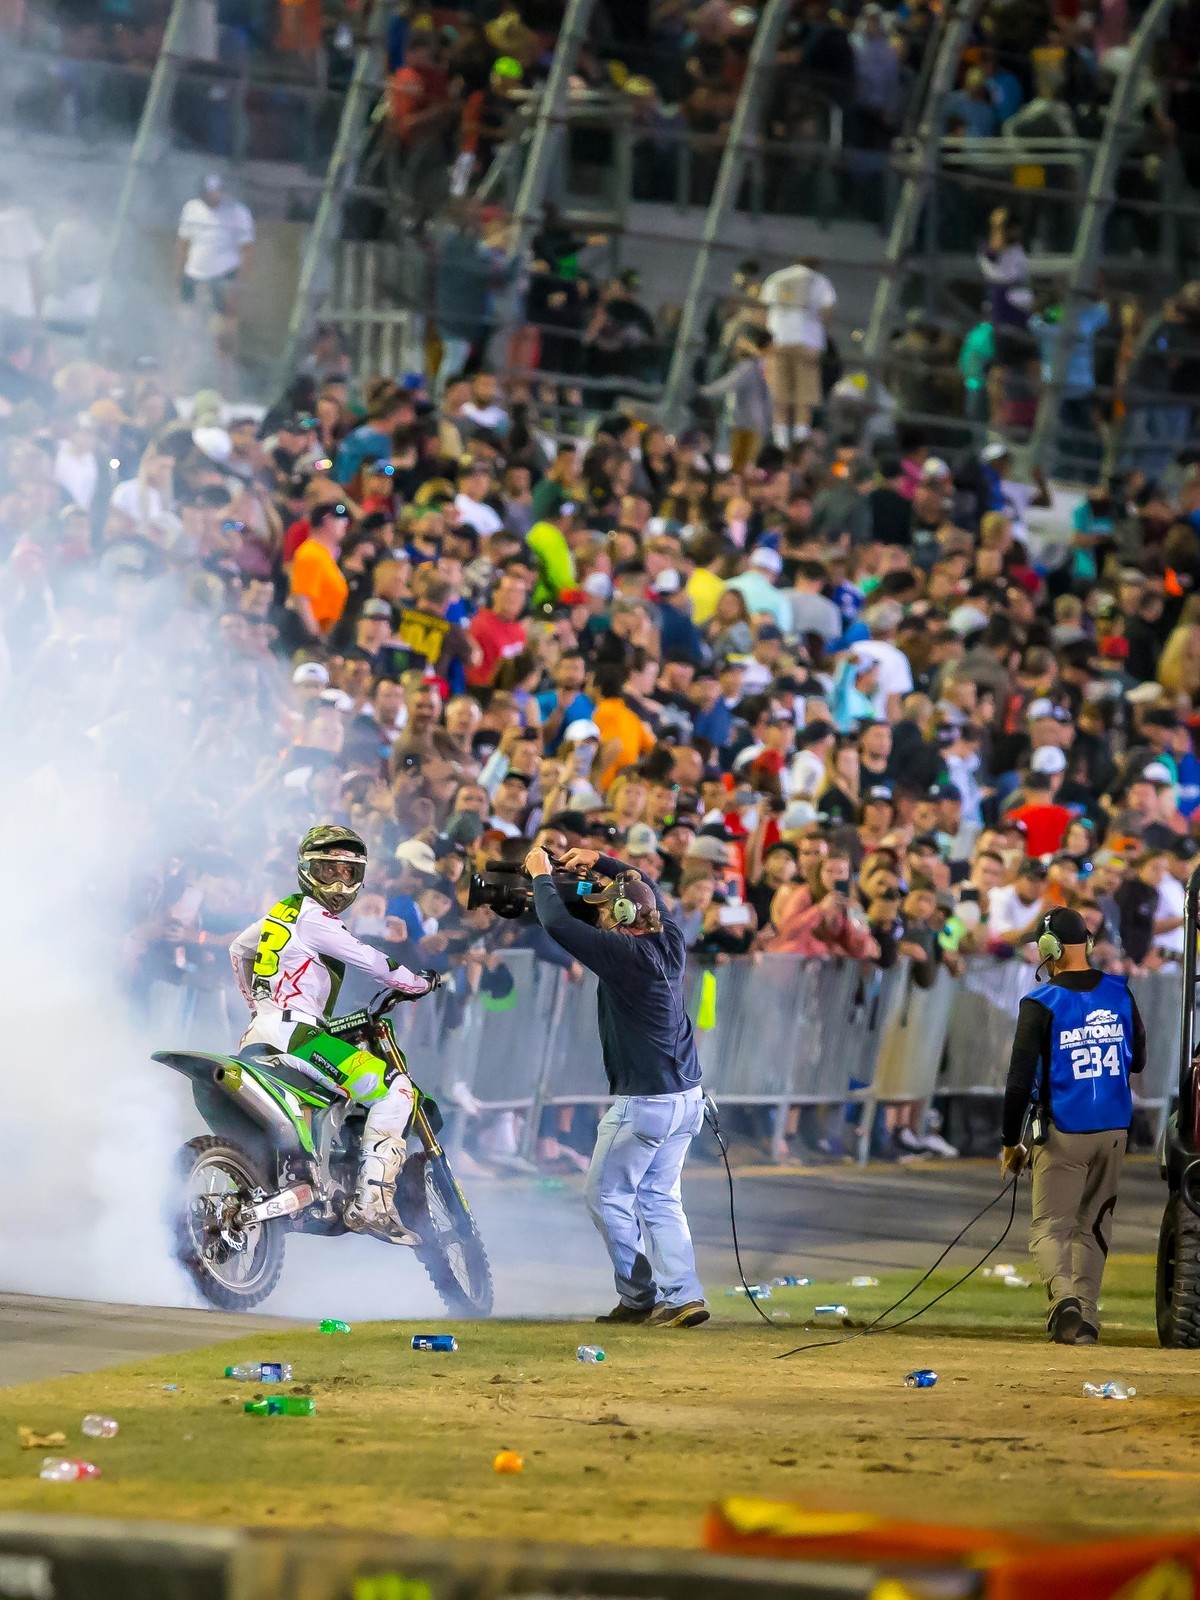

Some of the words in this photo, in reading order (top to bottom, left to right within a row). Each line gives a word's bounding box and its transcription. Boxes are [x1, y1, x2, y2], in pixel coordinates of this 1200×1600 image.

[253, 918, 292, 978] 3
[330, 1012, 366, 1028] RENTHAL
[330, 1018, 369, 1034] RENTHAL
[1060, 1023, 1124, 1045] DAYTONA
[1071, 1045, 1120, 1080] 234
